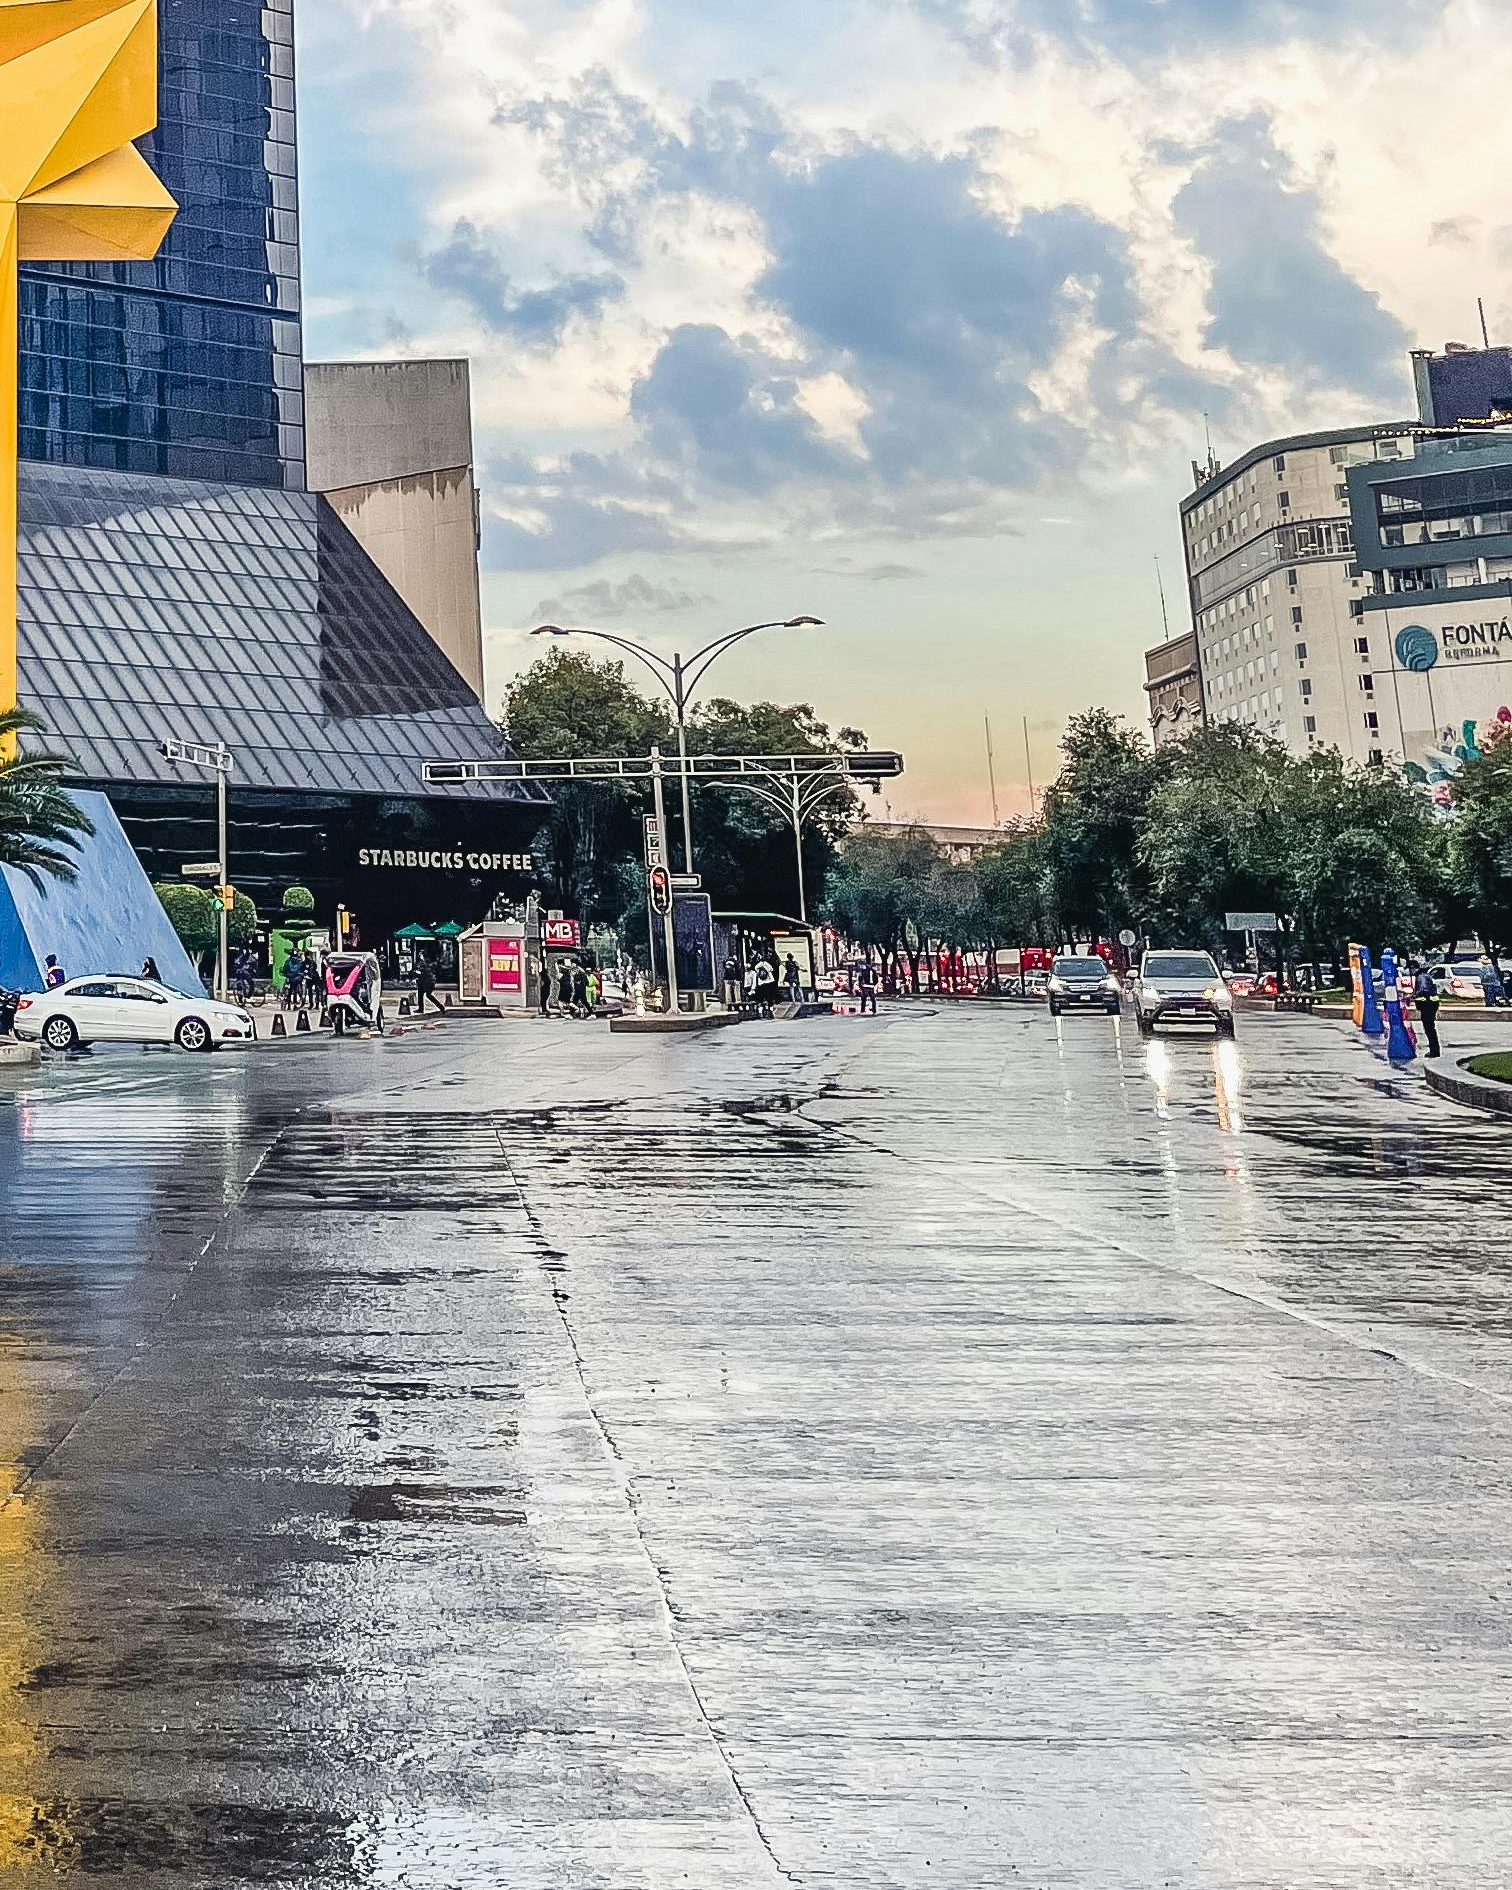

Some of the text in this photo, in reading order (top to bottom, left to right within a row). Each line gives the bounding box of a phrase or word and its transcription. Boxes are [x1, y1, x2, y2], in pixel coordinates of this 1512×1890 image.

[358, 848, 533, 870] STARBUCKS COFFEE
[545, 922, 573, 939] MB
